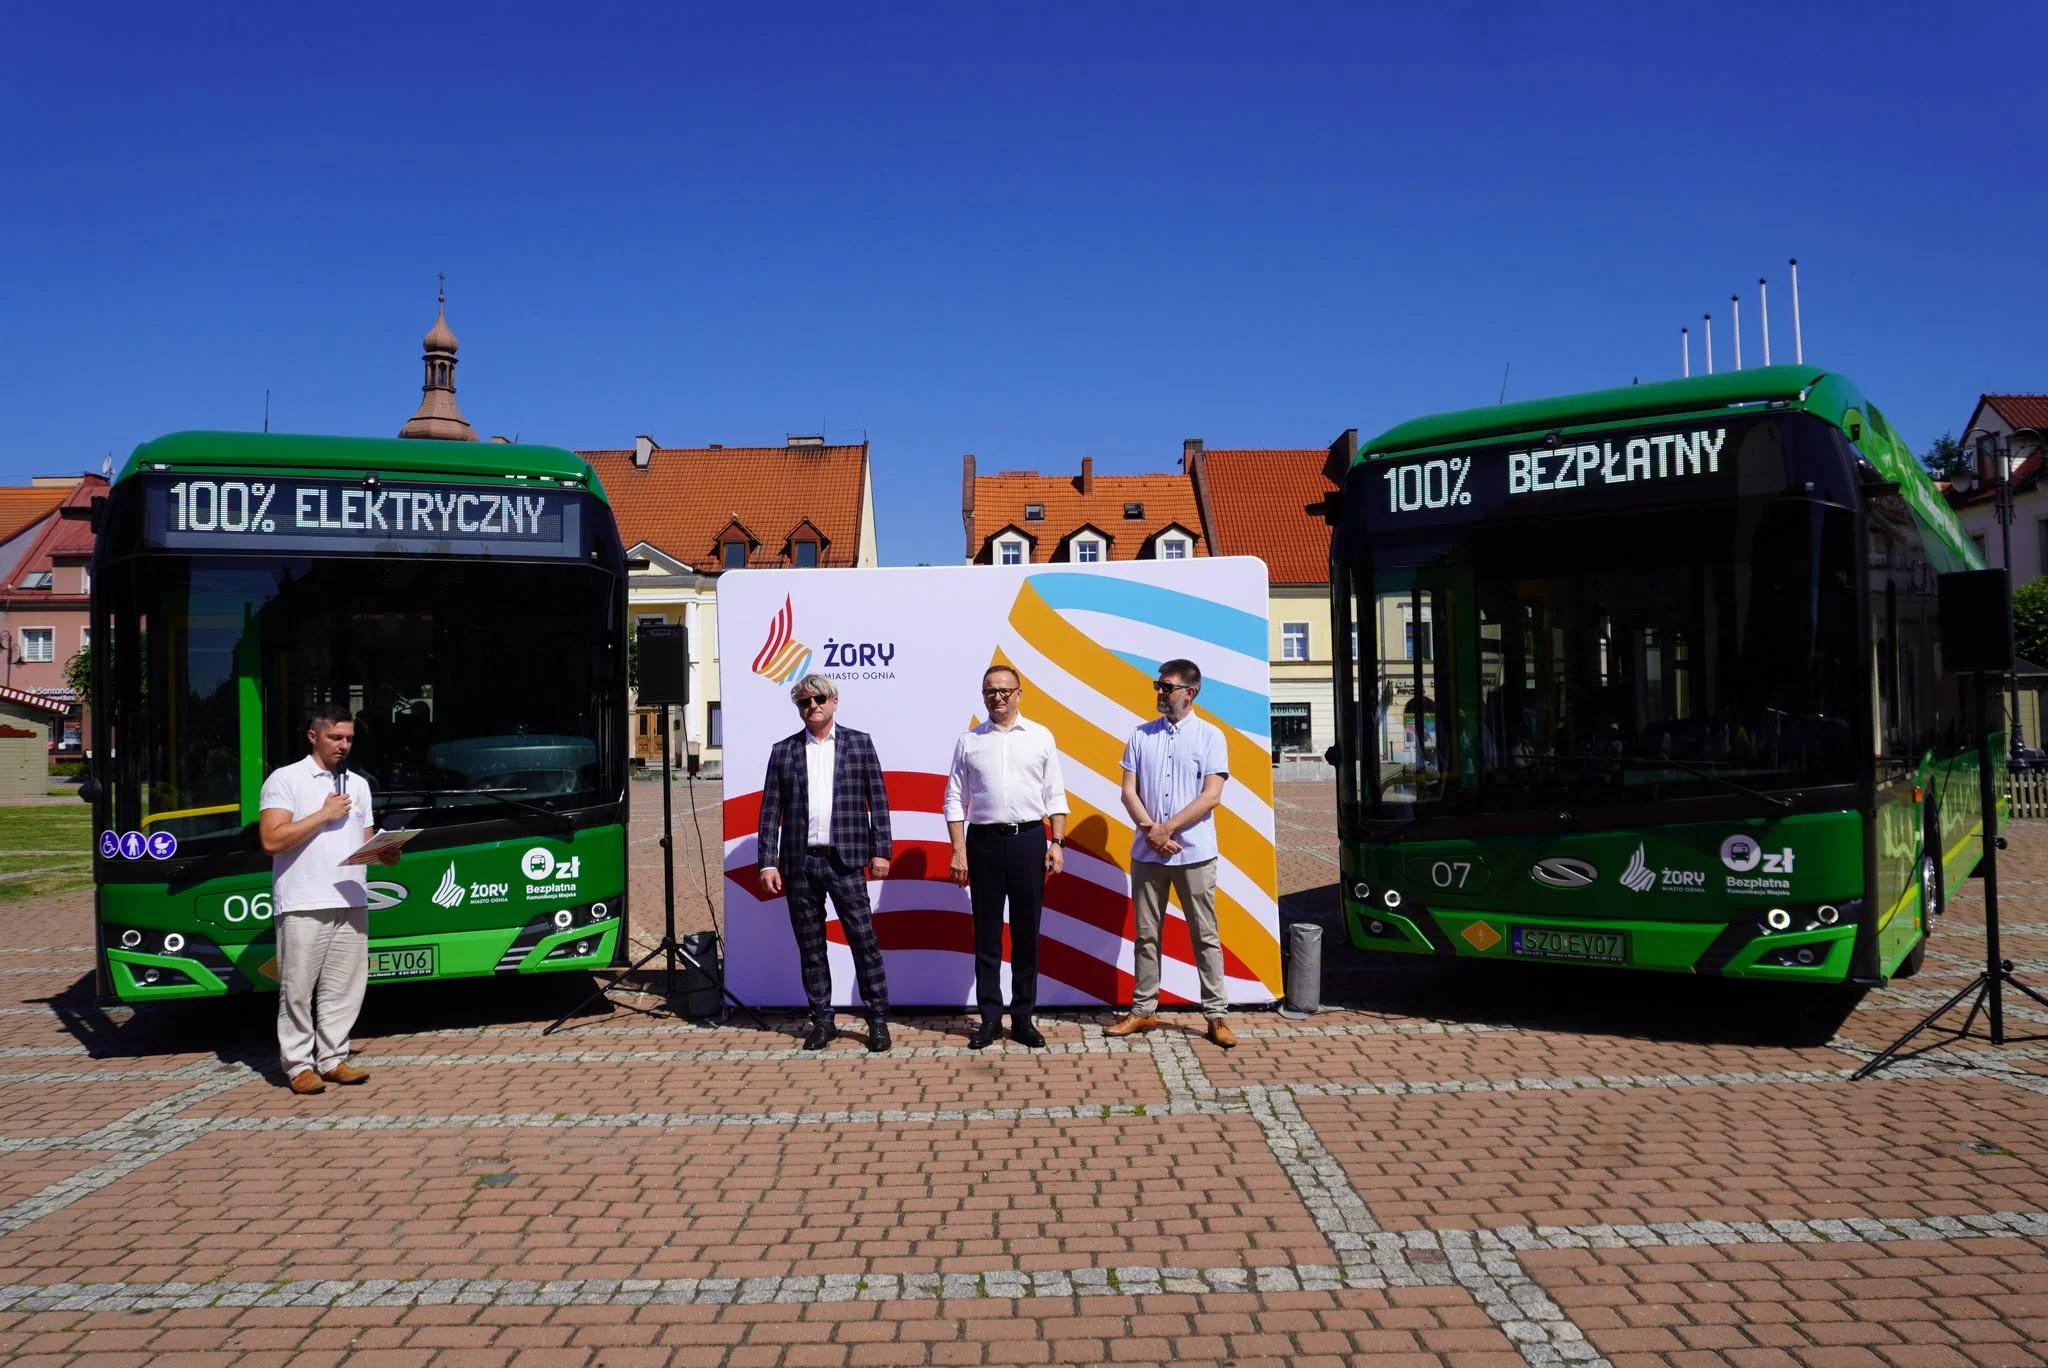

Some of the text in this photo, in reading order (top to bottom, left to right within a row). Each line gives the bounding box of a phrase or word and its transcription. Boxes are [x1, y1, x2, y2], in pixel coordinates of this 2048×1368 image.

[1384, 428, 1726, 513] 100% BEZPŁATNY
[171, 481, 545, 534] 100% ELEKTRYCZNY
[823, 637, 895, 667] ŻORY
[824, 671, 896, 680] MIASTO OGNIA
[37, 687, 77, 695] Santande
[1432, 862, 1471, 888] 07
[1661, 867, 1705, 886] ŻORY
[1726, 876, 1790, 890] Bezpłatna
[470, 882, 508, 898] ŻORY
[526, 883, 576, 895] Bezpłatna
[224, 893, 273, 922] 06
[1569, 934, 1618, 955] EV07
